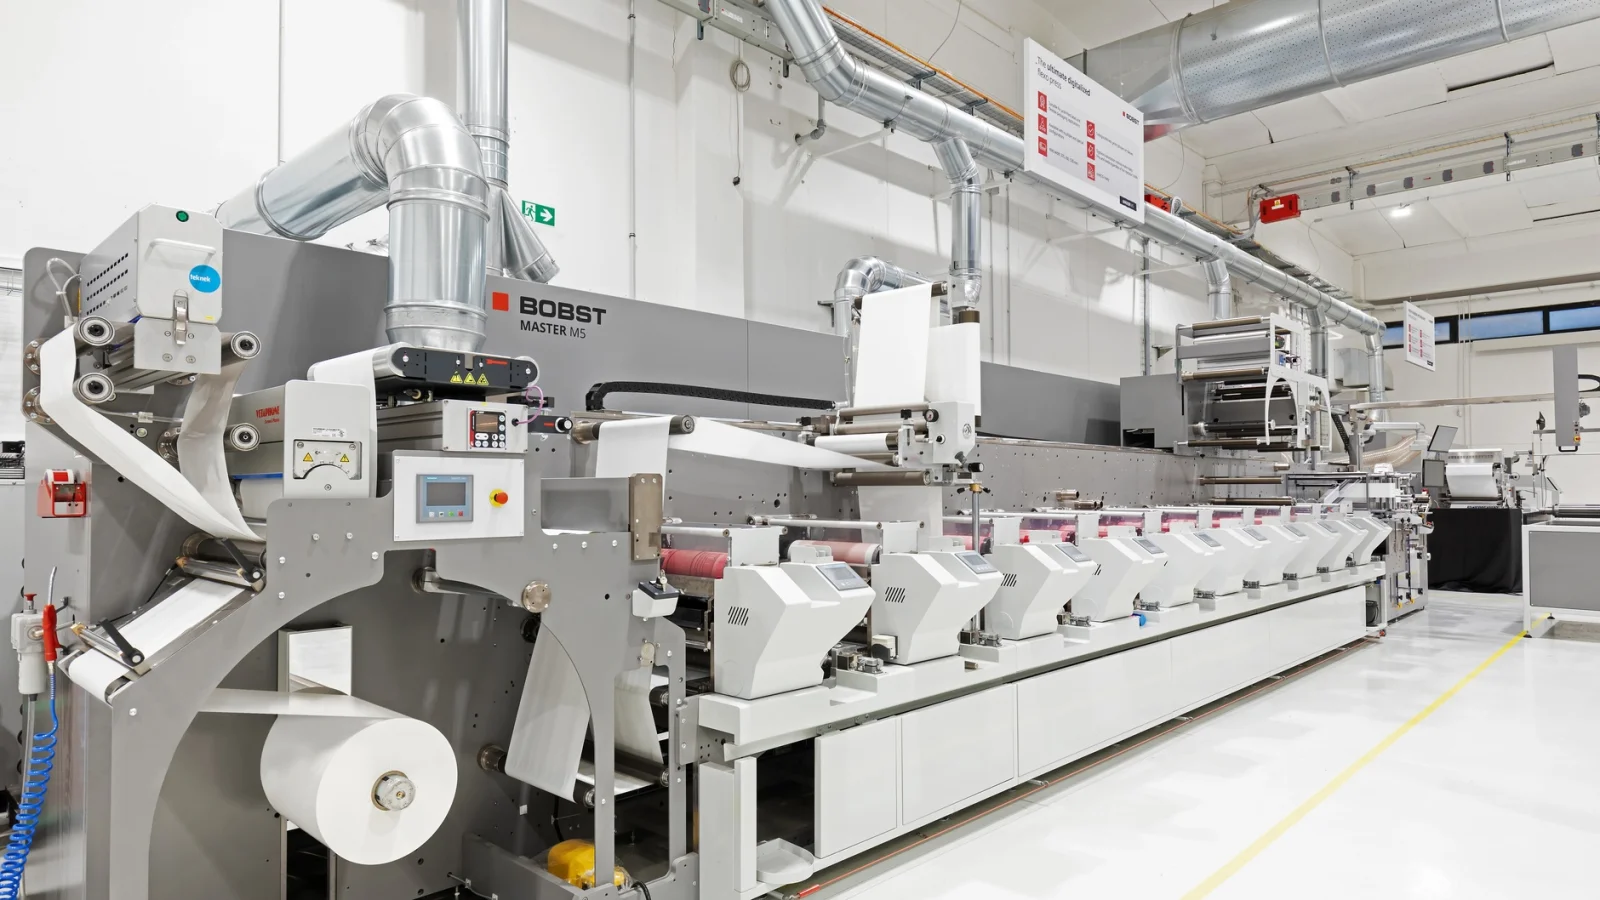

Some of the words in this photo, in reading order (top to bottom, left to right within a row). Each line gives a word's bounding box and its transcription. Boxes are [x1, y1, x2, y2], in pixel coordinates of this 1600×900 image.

[1037, 56, 1047, 68] The
[1047, 64, 1067, 82] ultimate
[1067, 77, 1091, 97] digitalized
[1037, 67, 1049, 82] flexo
[1049, 77, 1062, 90] press
[190, 274, 211, 283] teknek
[519, 295, 607, 325] BOBST
[520, 319, 567, 337] MASTER
[569, 326, 587, 340] M5
